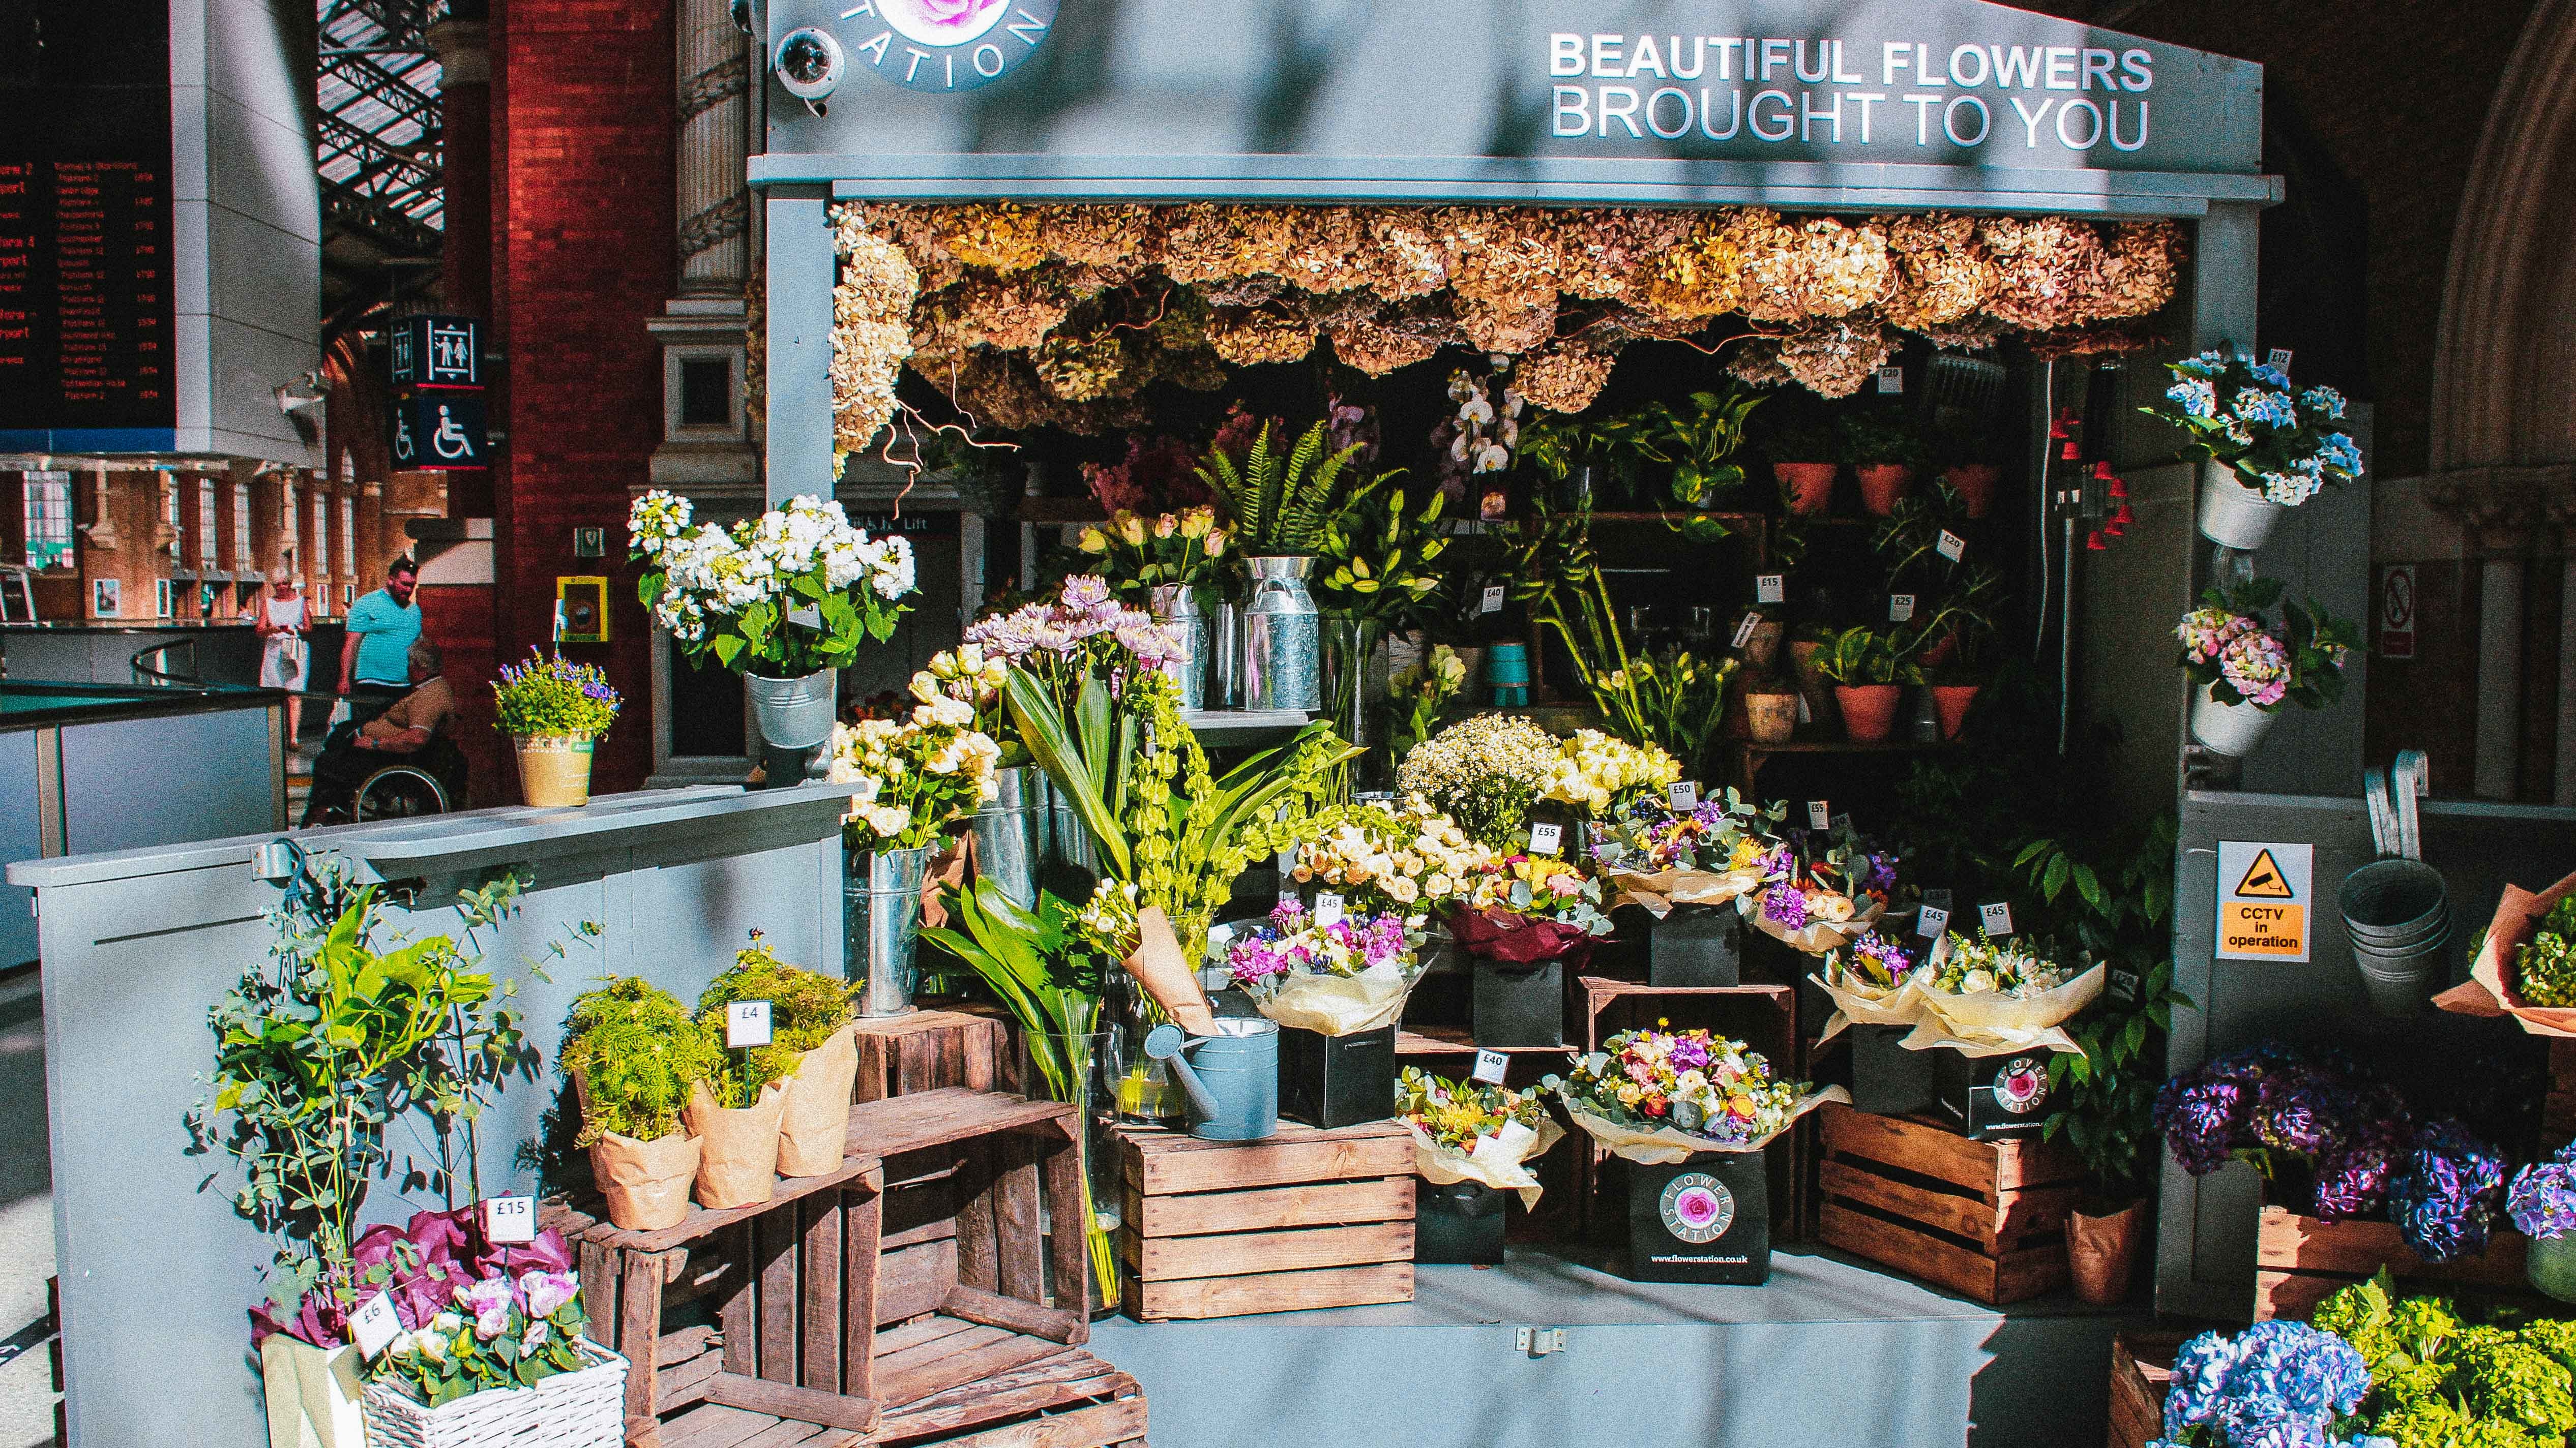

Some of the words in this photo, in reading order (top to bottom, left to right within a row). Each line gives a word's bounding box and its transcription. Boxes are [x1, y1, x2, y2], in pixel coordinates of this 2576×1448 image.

[840, 0, 1046, 88] TATION
[1549, 32, 1861, 84] BEAUTIFUL
[1883, 42, 2153, 92] FLOWERS
[1552, 85, 1886, 144] BROUGHT
[1903, 93, 1990, 148] TO
[2009, 97, 2150, 152] YOU
[2272, 352, 2288, 363] £12
[905, 517, 928, 529] Lift
[1944, 534, 1960, 548] £20
[1762, 577, 1779, 586] £15
[1487, 588, 1501, 597] £40
[1673, 785, 1691, 794] £50
[1811, 803, 1824, 812] £55
[1537, 827, 1556, 837] £55
[1322, 898, 1338, 908] £45
[1924, 909, 1943, 921] £45
[1986, 905, 2004, 917] £45
[2240, 907, 2284, 920] CCTV
[2255, 921, 2268, 933] in
[2229, 936, 2298, 949] operation
[742, 1007, 759, 1019] £4
[1483, 1053, 1503, 1066] £40
[1996, 1087, 2047, 1112] STATION
[1985, 1122, 2045, 1130] www.flowerstation.c
[1664, 1174, 1730, 1204] FLOWER
[497, 1201, 525, 1215] £15
[1663, 1208, 1732, 1242] STATION
[1651, 1254, 1749, 1263] www.flowerstation.co.uk
[365, 1303, 380, 1324] £6
